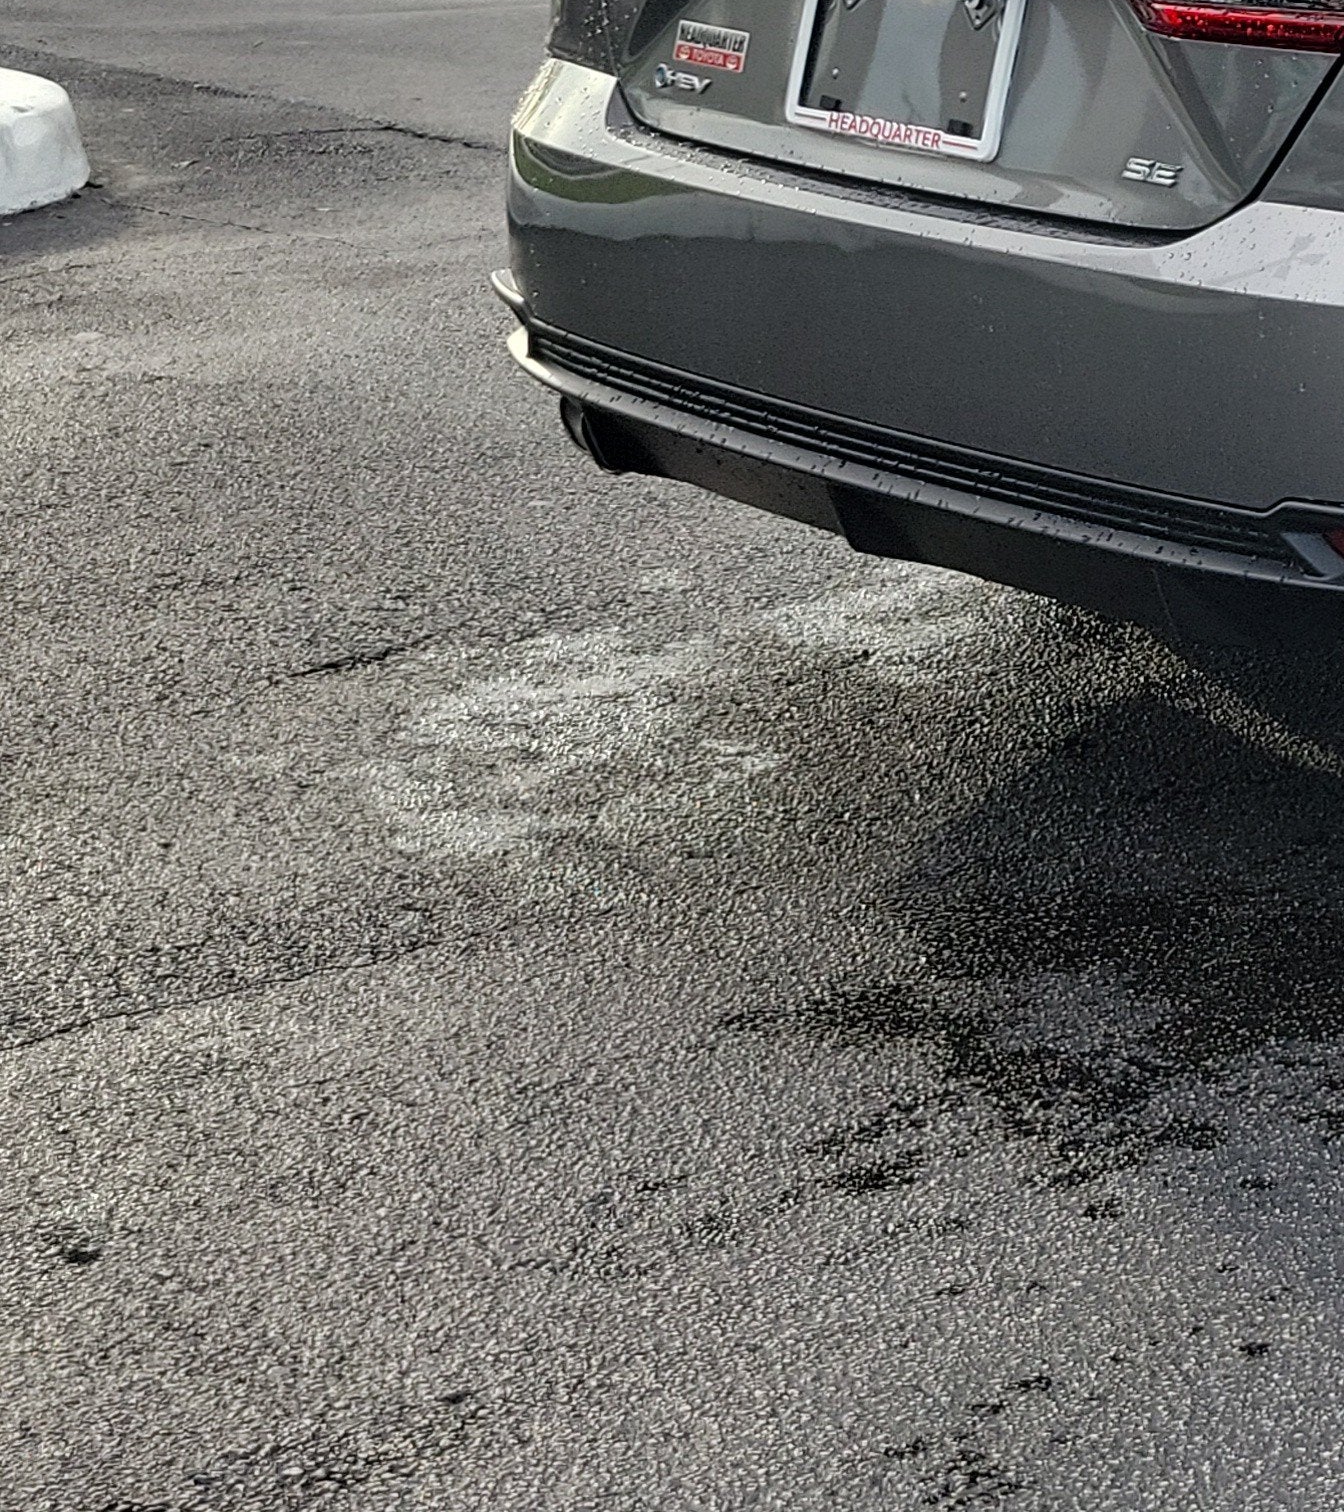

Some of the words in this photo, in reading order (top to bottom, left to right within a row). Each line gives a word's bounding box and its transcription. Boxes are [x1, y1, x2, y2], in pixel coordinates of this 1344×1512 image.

[679, 23, 747, 54] HEADQUARTER
[692, 49, 725, 66] TOYOTA
[667, 69, 713, 95] HEV
[828, 111, 942, 150] HEADQUARTER
[1122, 157, 1184, 188] SE
